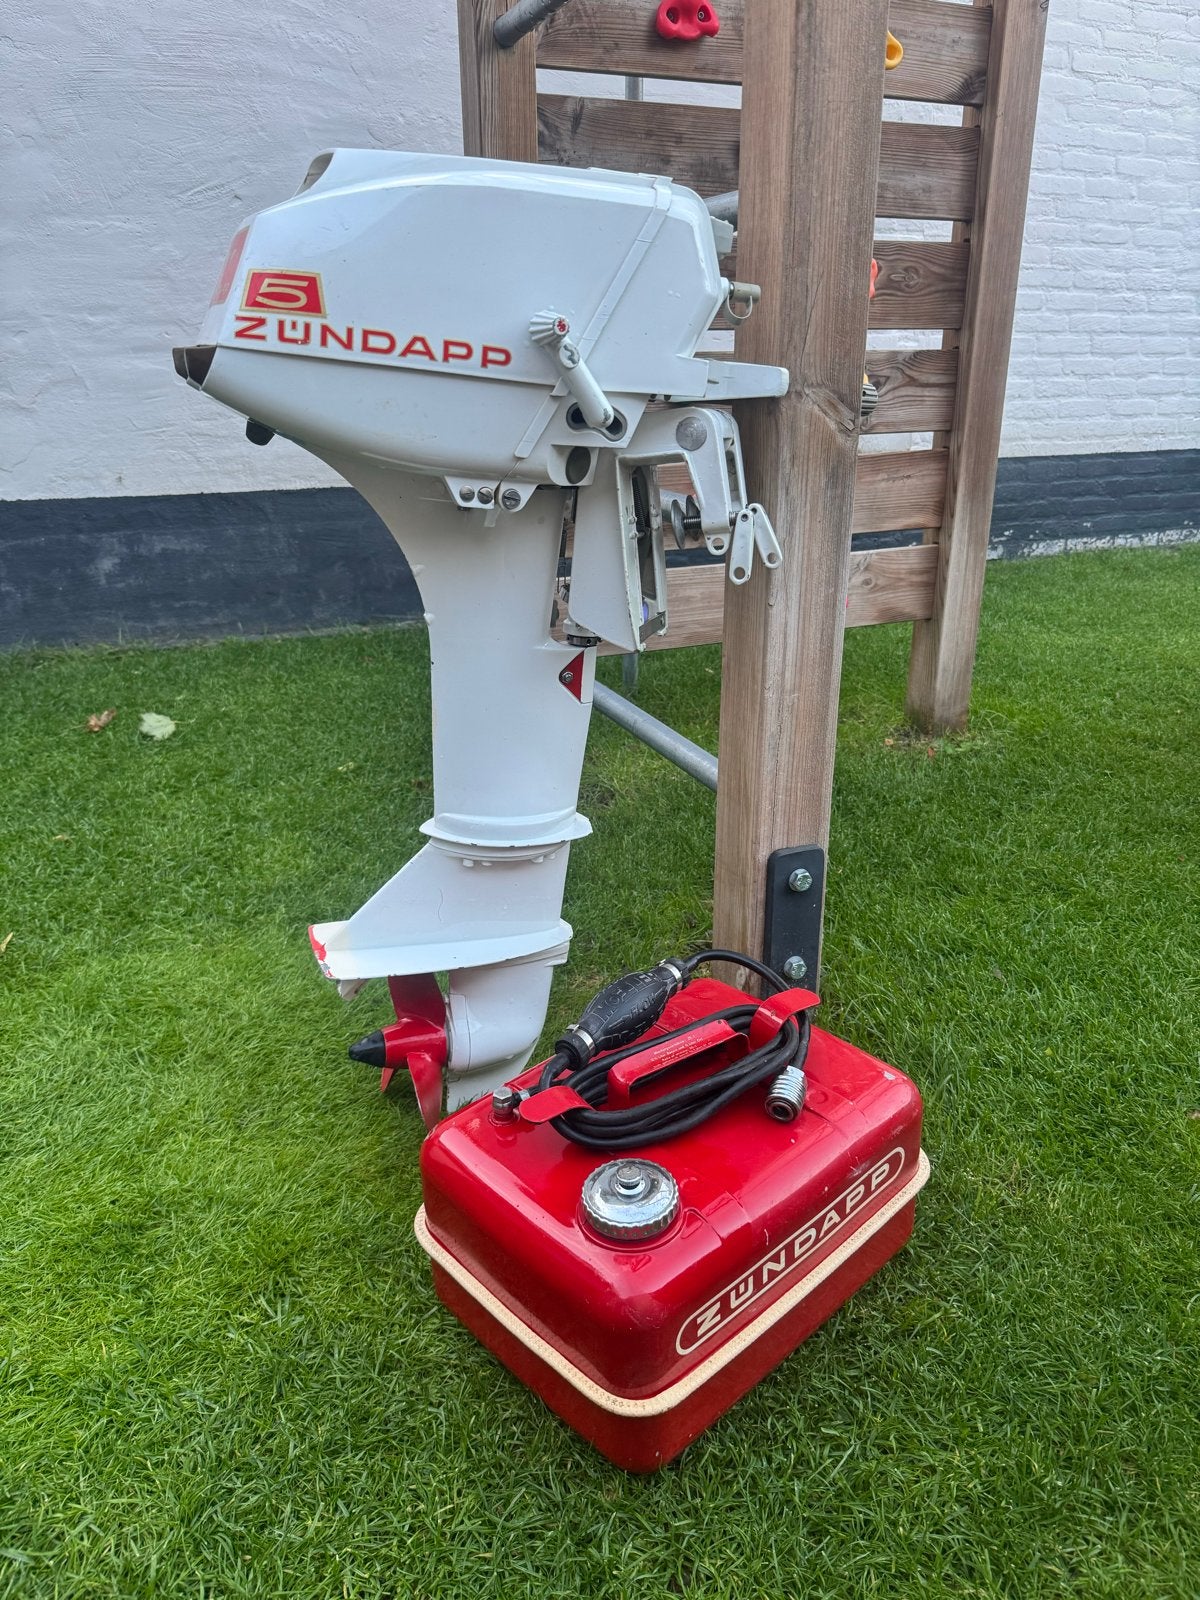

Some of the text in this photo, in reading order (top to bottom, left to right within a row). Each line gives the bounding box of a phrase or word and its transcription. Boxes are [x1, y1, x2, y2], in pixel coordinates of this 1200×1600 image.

[255, 278, 308, 309] 5
[234, 315, 512, 368] ZÜNDAPP
[697, 1162, 889, 1337] ZÜNDAPP
